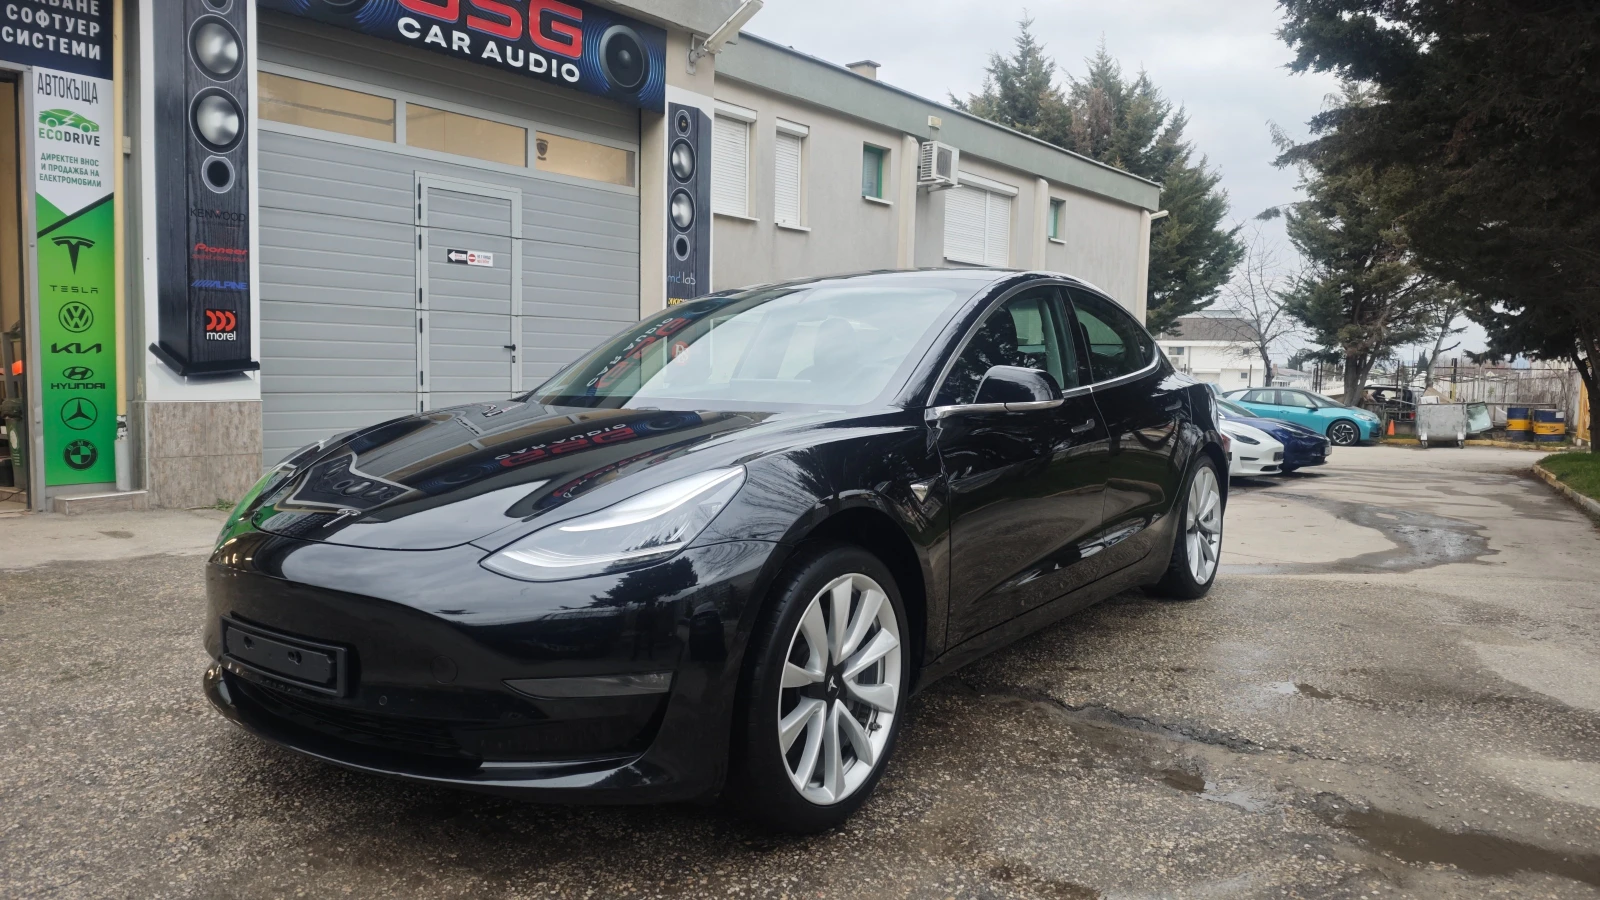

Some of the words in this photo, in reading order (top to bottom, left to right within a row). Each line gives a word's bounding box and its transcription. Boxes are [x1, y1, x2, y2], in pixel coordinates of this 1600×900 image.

[28, 0, 100, 16] АНЕ
[6, 3, 101, 37] СОФТУЕР
[1, 26, 101, 60] СИСТЕМИ
[397, 16, 471, 54] CAR
[481, 40, 580, 83] AUDIO
[37, 72, 98, 105] АВТОКЪЩА
[39, 128, 100, 147] ECODRIVE
[41, 152, 79, 164] ДИРЕКТЕН
[80, 157, 99, 167] ВНОС
[41, 163, 46, 171] И
[48, 163, 88, 176] ПРОДАЖБА
[90, 169, 100, 177] НА
[39, 173, 101, 187] ЕЛЕКТРОМОБИЛИ
[190, 208, 246, 222] KENWOOD
[194, 243, 247, 255] Pioneer
[49, 285, 99, 294] TESLA
[200, 280, 248, 290] ALPINE
[206, 331, 236, 341] morel
[51, 342, 102, 354] KIA
[51, 382, 106, 390] HYUNDAI
